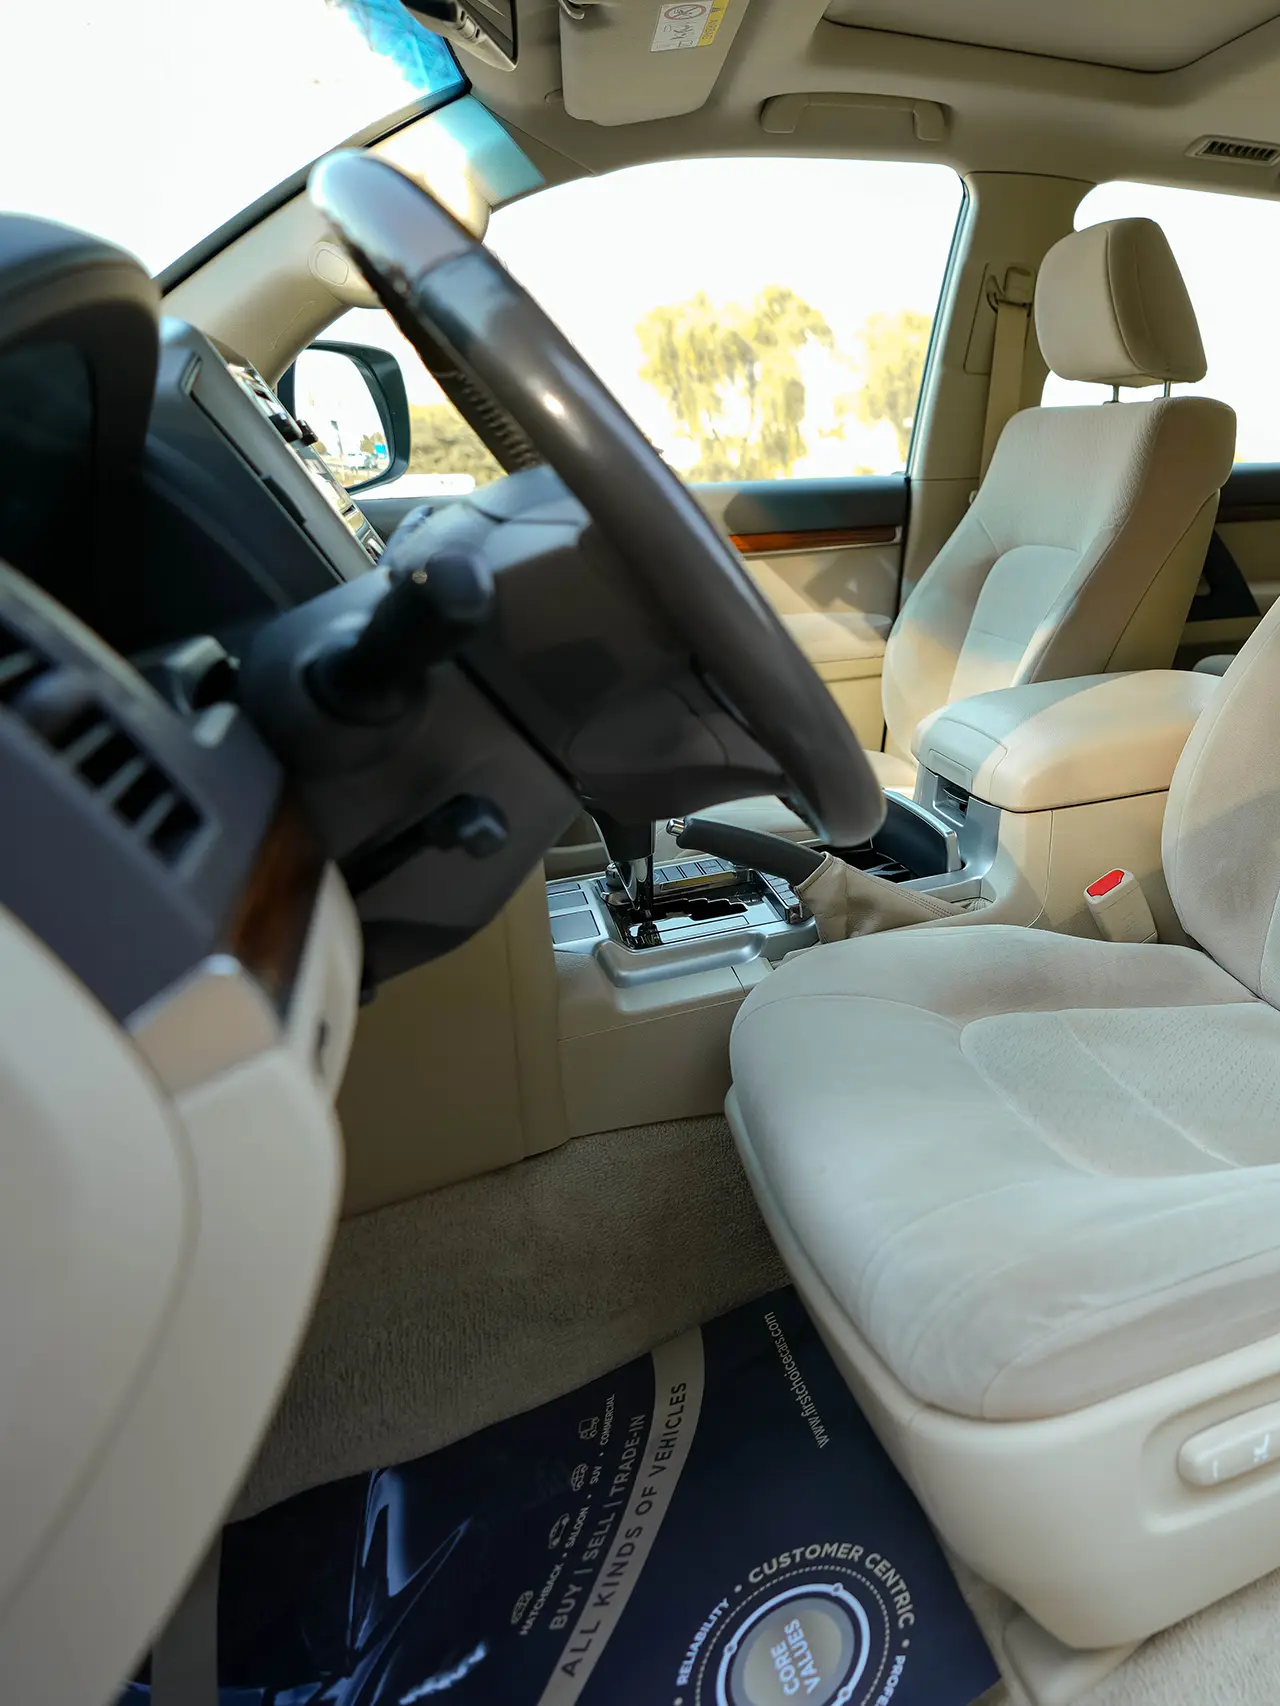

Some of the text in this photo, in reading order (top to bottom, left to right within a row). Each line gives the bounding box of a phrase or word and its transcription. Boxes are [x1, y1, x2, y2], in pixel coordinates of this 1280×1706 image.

[764, 1311, 831, 1448] www.firstchoicecars.com
[519, 1394, 616, 1635] HATCHBACK SALOON SUV COMMERCIAL
[549, 1413, 646, 1630] BUY SELL TRADE-IN
[561, 1382, 687, 1678] ALL KINDS OF VEHICLES
[676, 1597, 731, 1686] RELIABILITY
[748, 1542, 864, 1584] CUSTOMER
[864, 1552, 915, 1630] CENTRIC
[770, 1640, 800, 1696] CORE
[784, 1618, 821, 1695] VALUES
